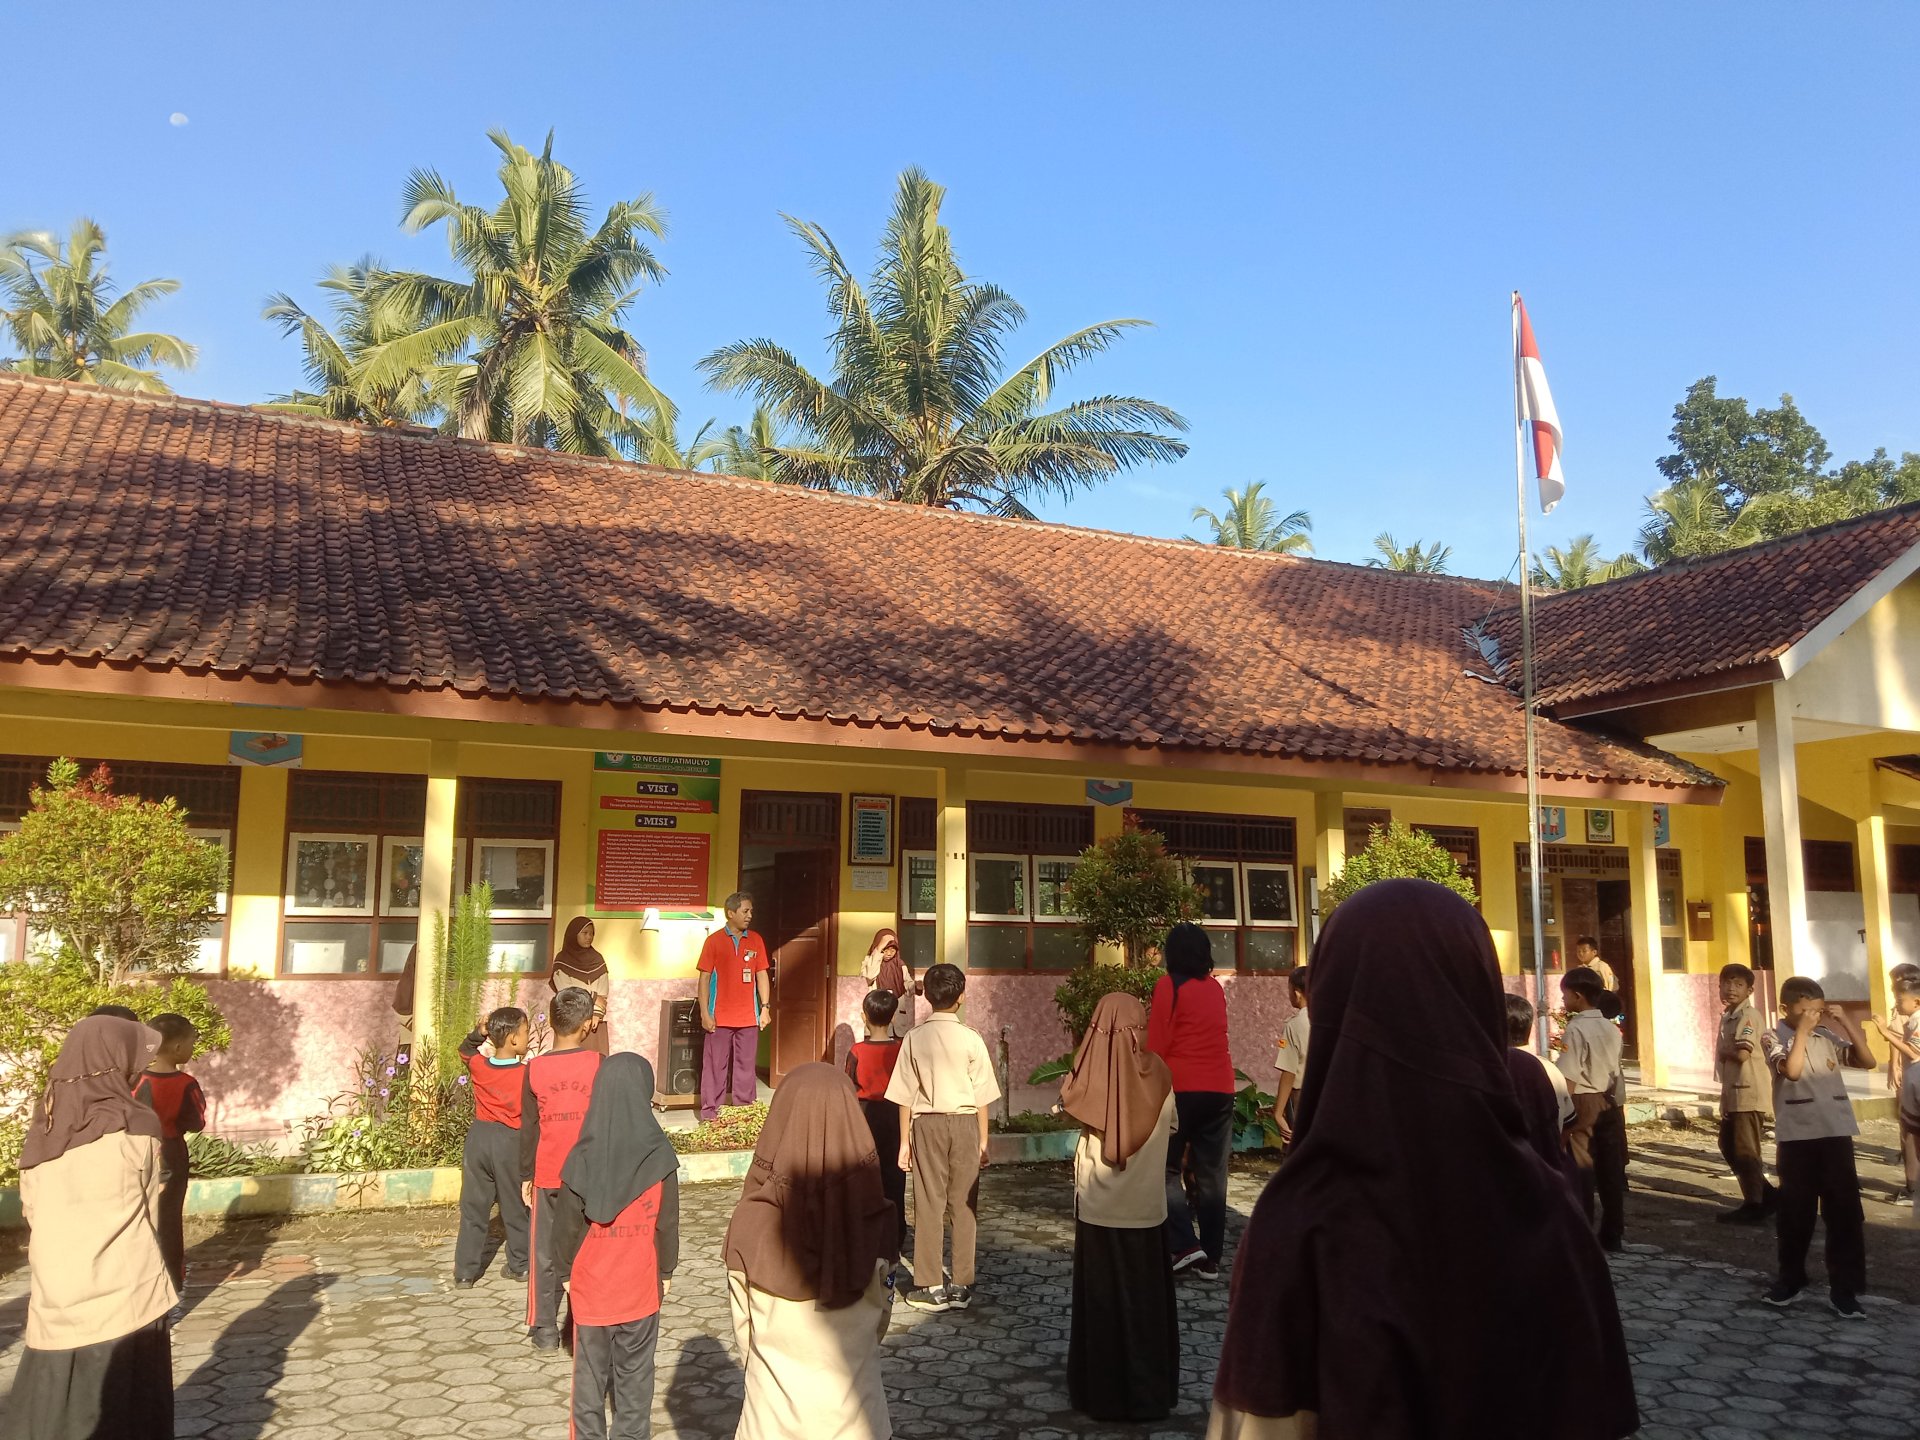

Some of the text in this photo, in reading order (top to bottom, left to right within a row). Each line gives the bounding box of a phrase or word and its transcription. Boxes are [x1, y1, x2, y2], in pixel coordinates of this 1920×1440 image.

[643, 756, 669, 764] NEGERI
[670, 757, 710, 766] JATIMULYO
[647, 784, 669, 793] VISI
[643, 816, 669, 826] MISI
[549, 1080, 592, 1099] NEGE
